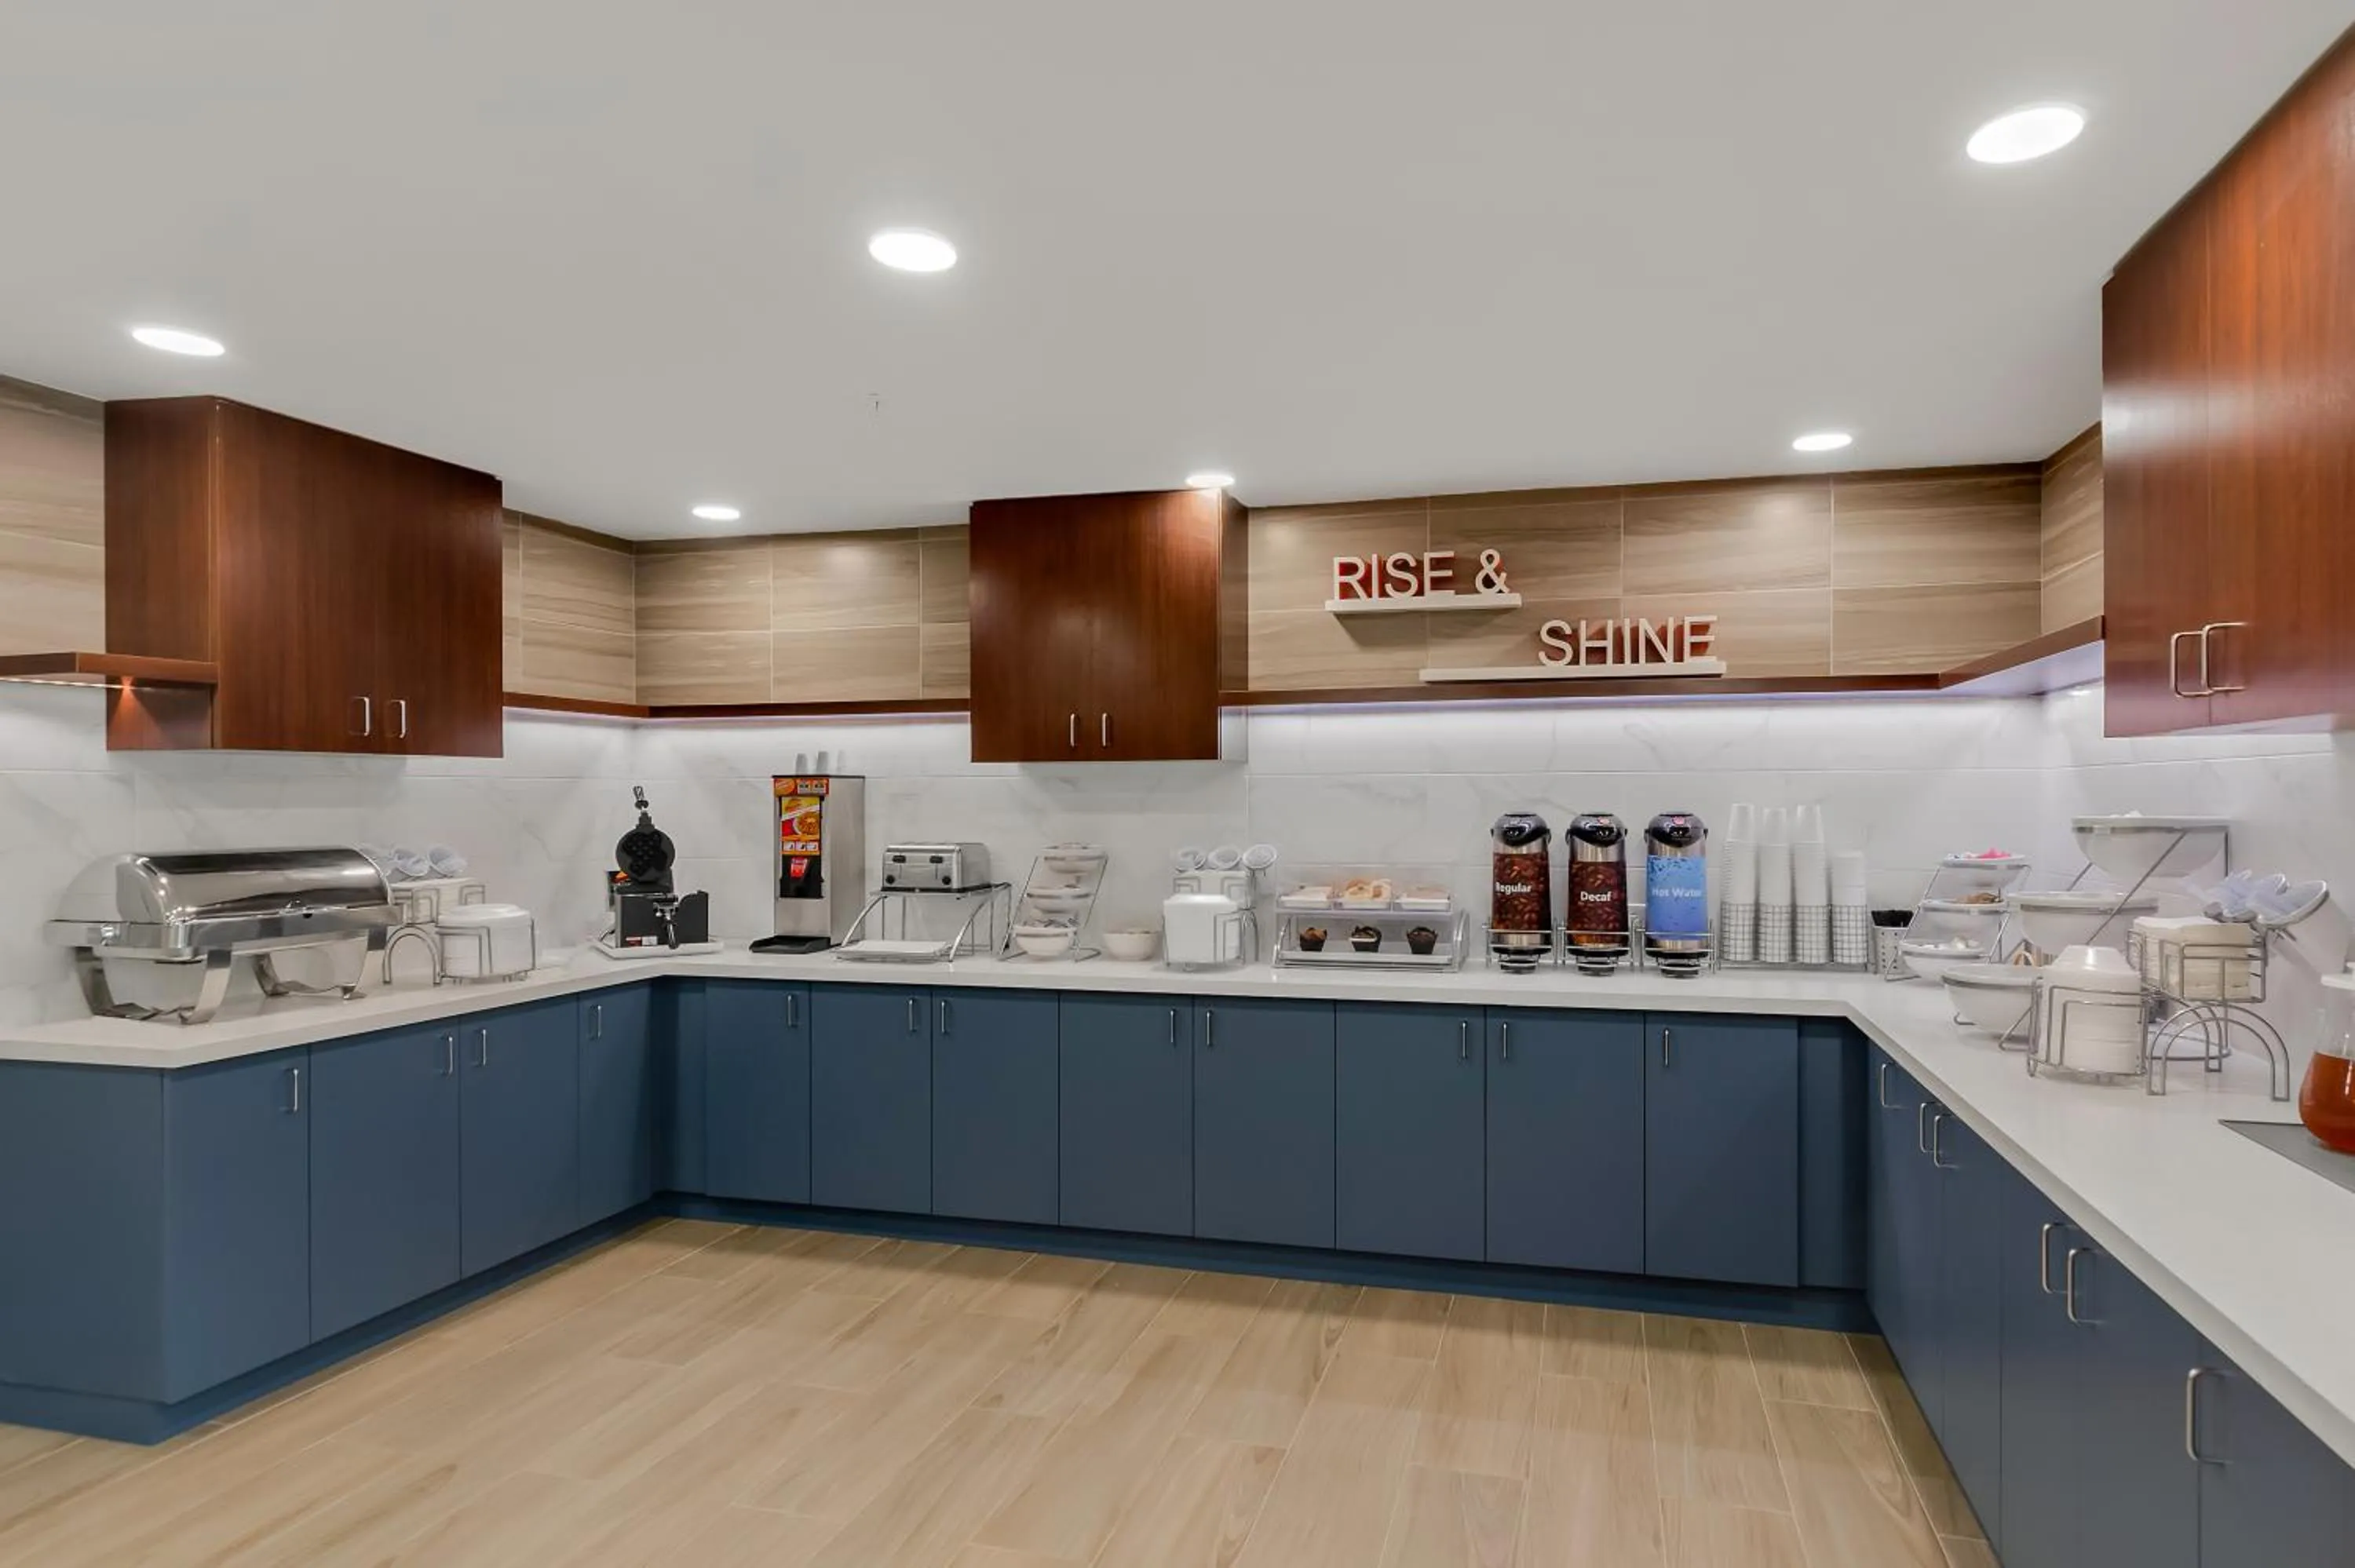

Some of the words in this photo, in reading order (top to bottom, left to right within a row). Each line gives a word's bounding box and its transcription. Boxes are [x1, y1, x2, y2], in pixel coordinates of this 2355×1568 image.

[1333, 551, 1455, 600] RISE
[1475, 549, 1510, 594] &
[1539, 615, 1718, 666] SHINE
[1580, 891, 1612, 902] Decaf
[1652, 887, 1669, 897] Hot
[1671, 887, 1703, 898] Water
